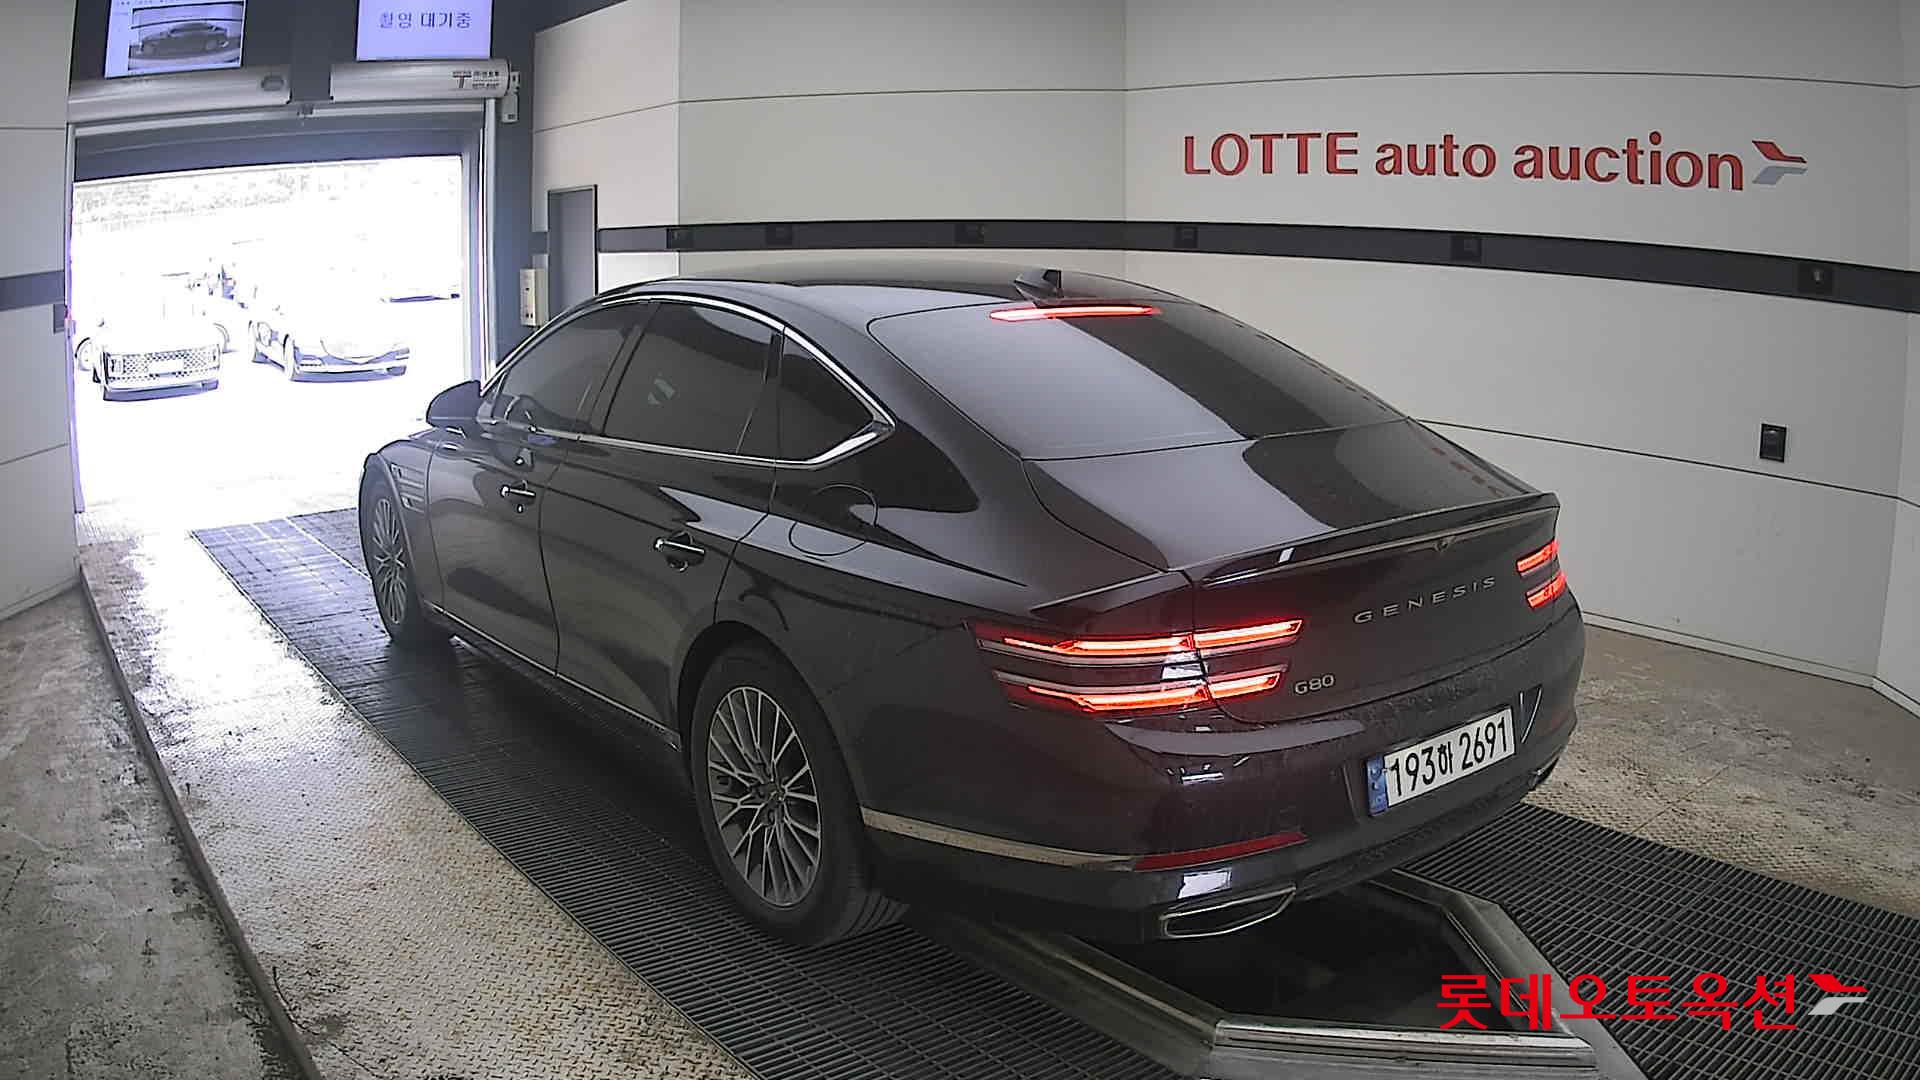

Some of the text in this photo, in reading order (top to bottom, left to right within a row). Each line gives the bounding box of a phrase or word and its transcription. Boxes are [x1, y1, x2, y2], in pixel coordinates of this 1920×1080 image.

[420, 10, 472, 29] 대기중
[1184, 131, 1744, 191] LOTTE auto auction
[1354, 576, 1496, 624] GENESIS
[1294, 674, 1336, 696] G80
[1389, 716, 1508, 797] 193하 2691
